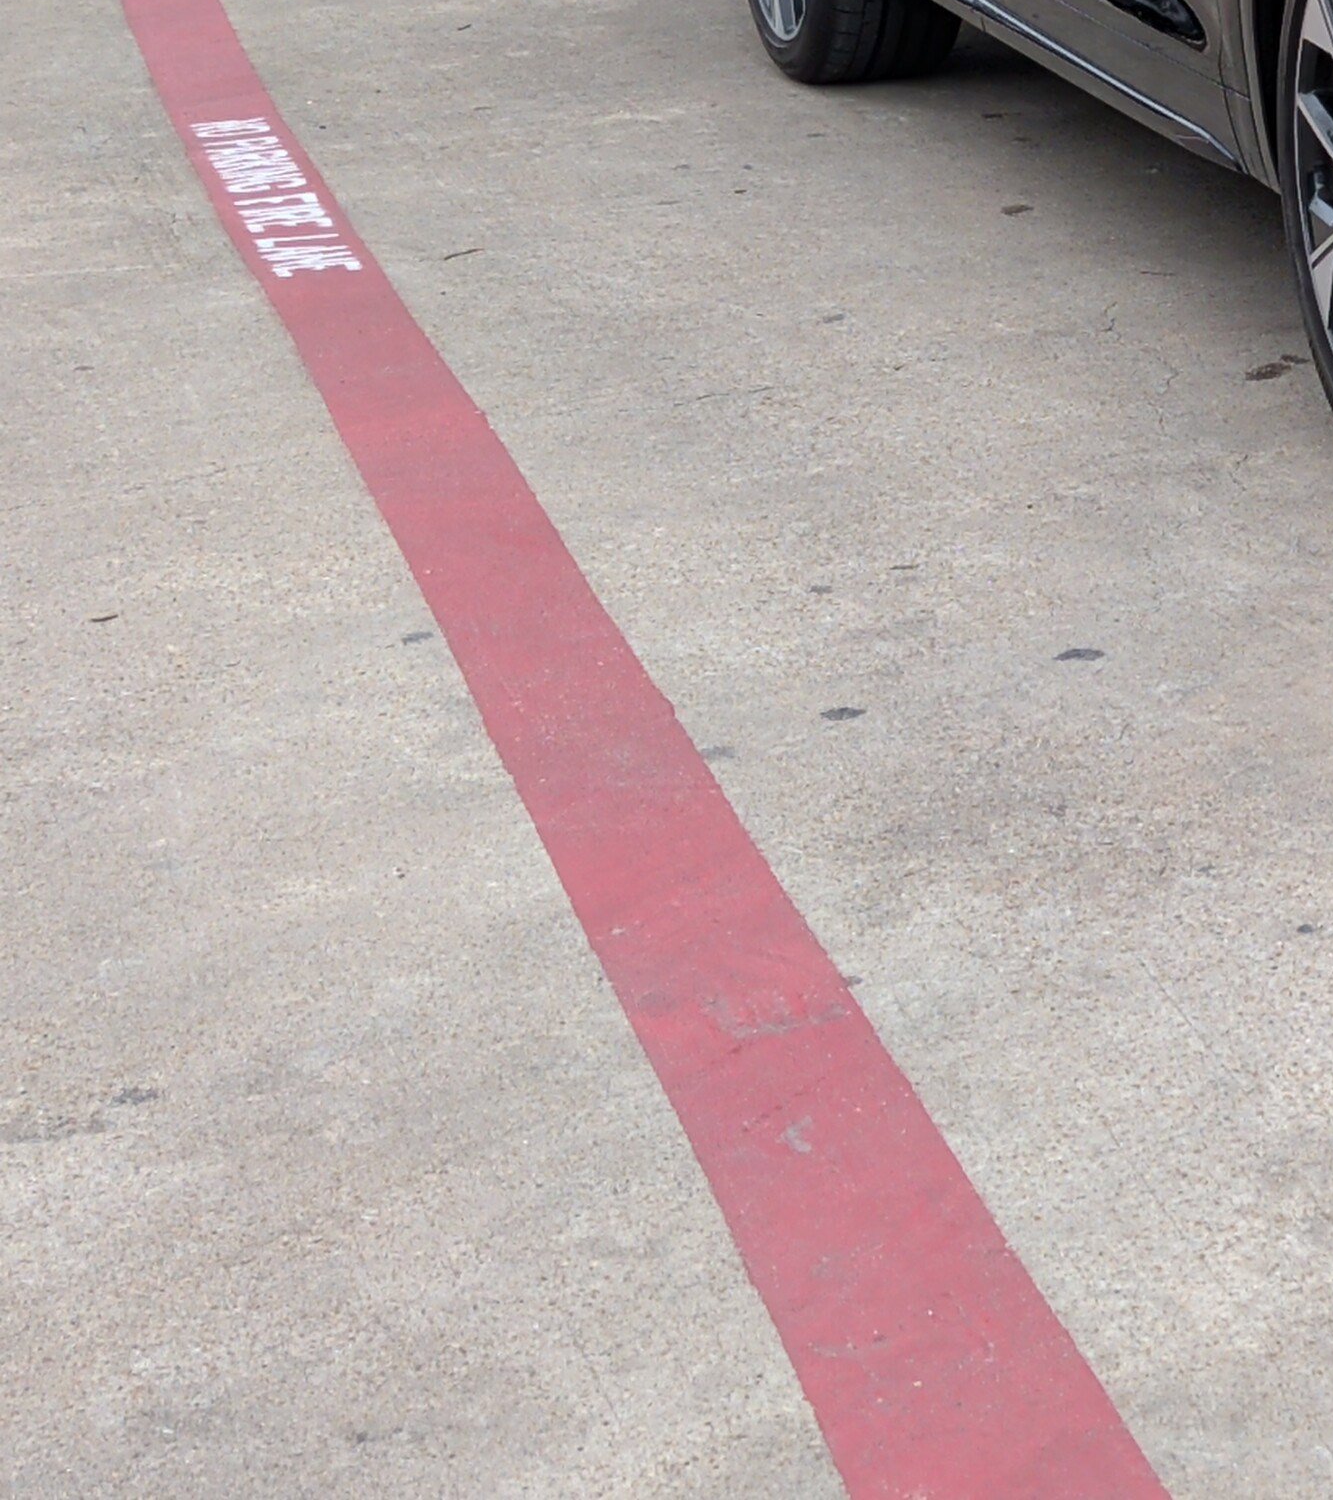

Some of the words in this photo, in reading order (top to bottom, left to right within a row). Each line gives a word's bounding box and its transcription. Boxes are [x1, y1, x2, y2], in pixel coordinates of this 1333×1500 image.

[202, 136, 307, 193] PARKING
[233, 192, 334, 233] FIRE
[253, 233, 363, 277] LANE
